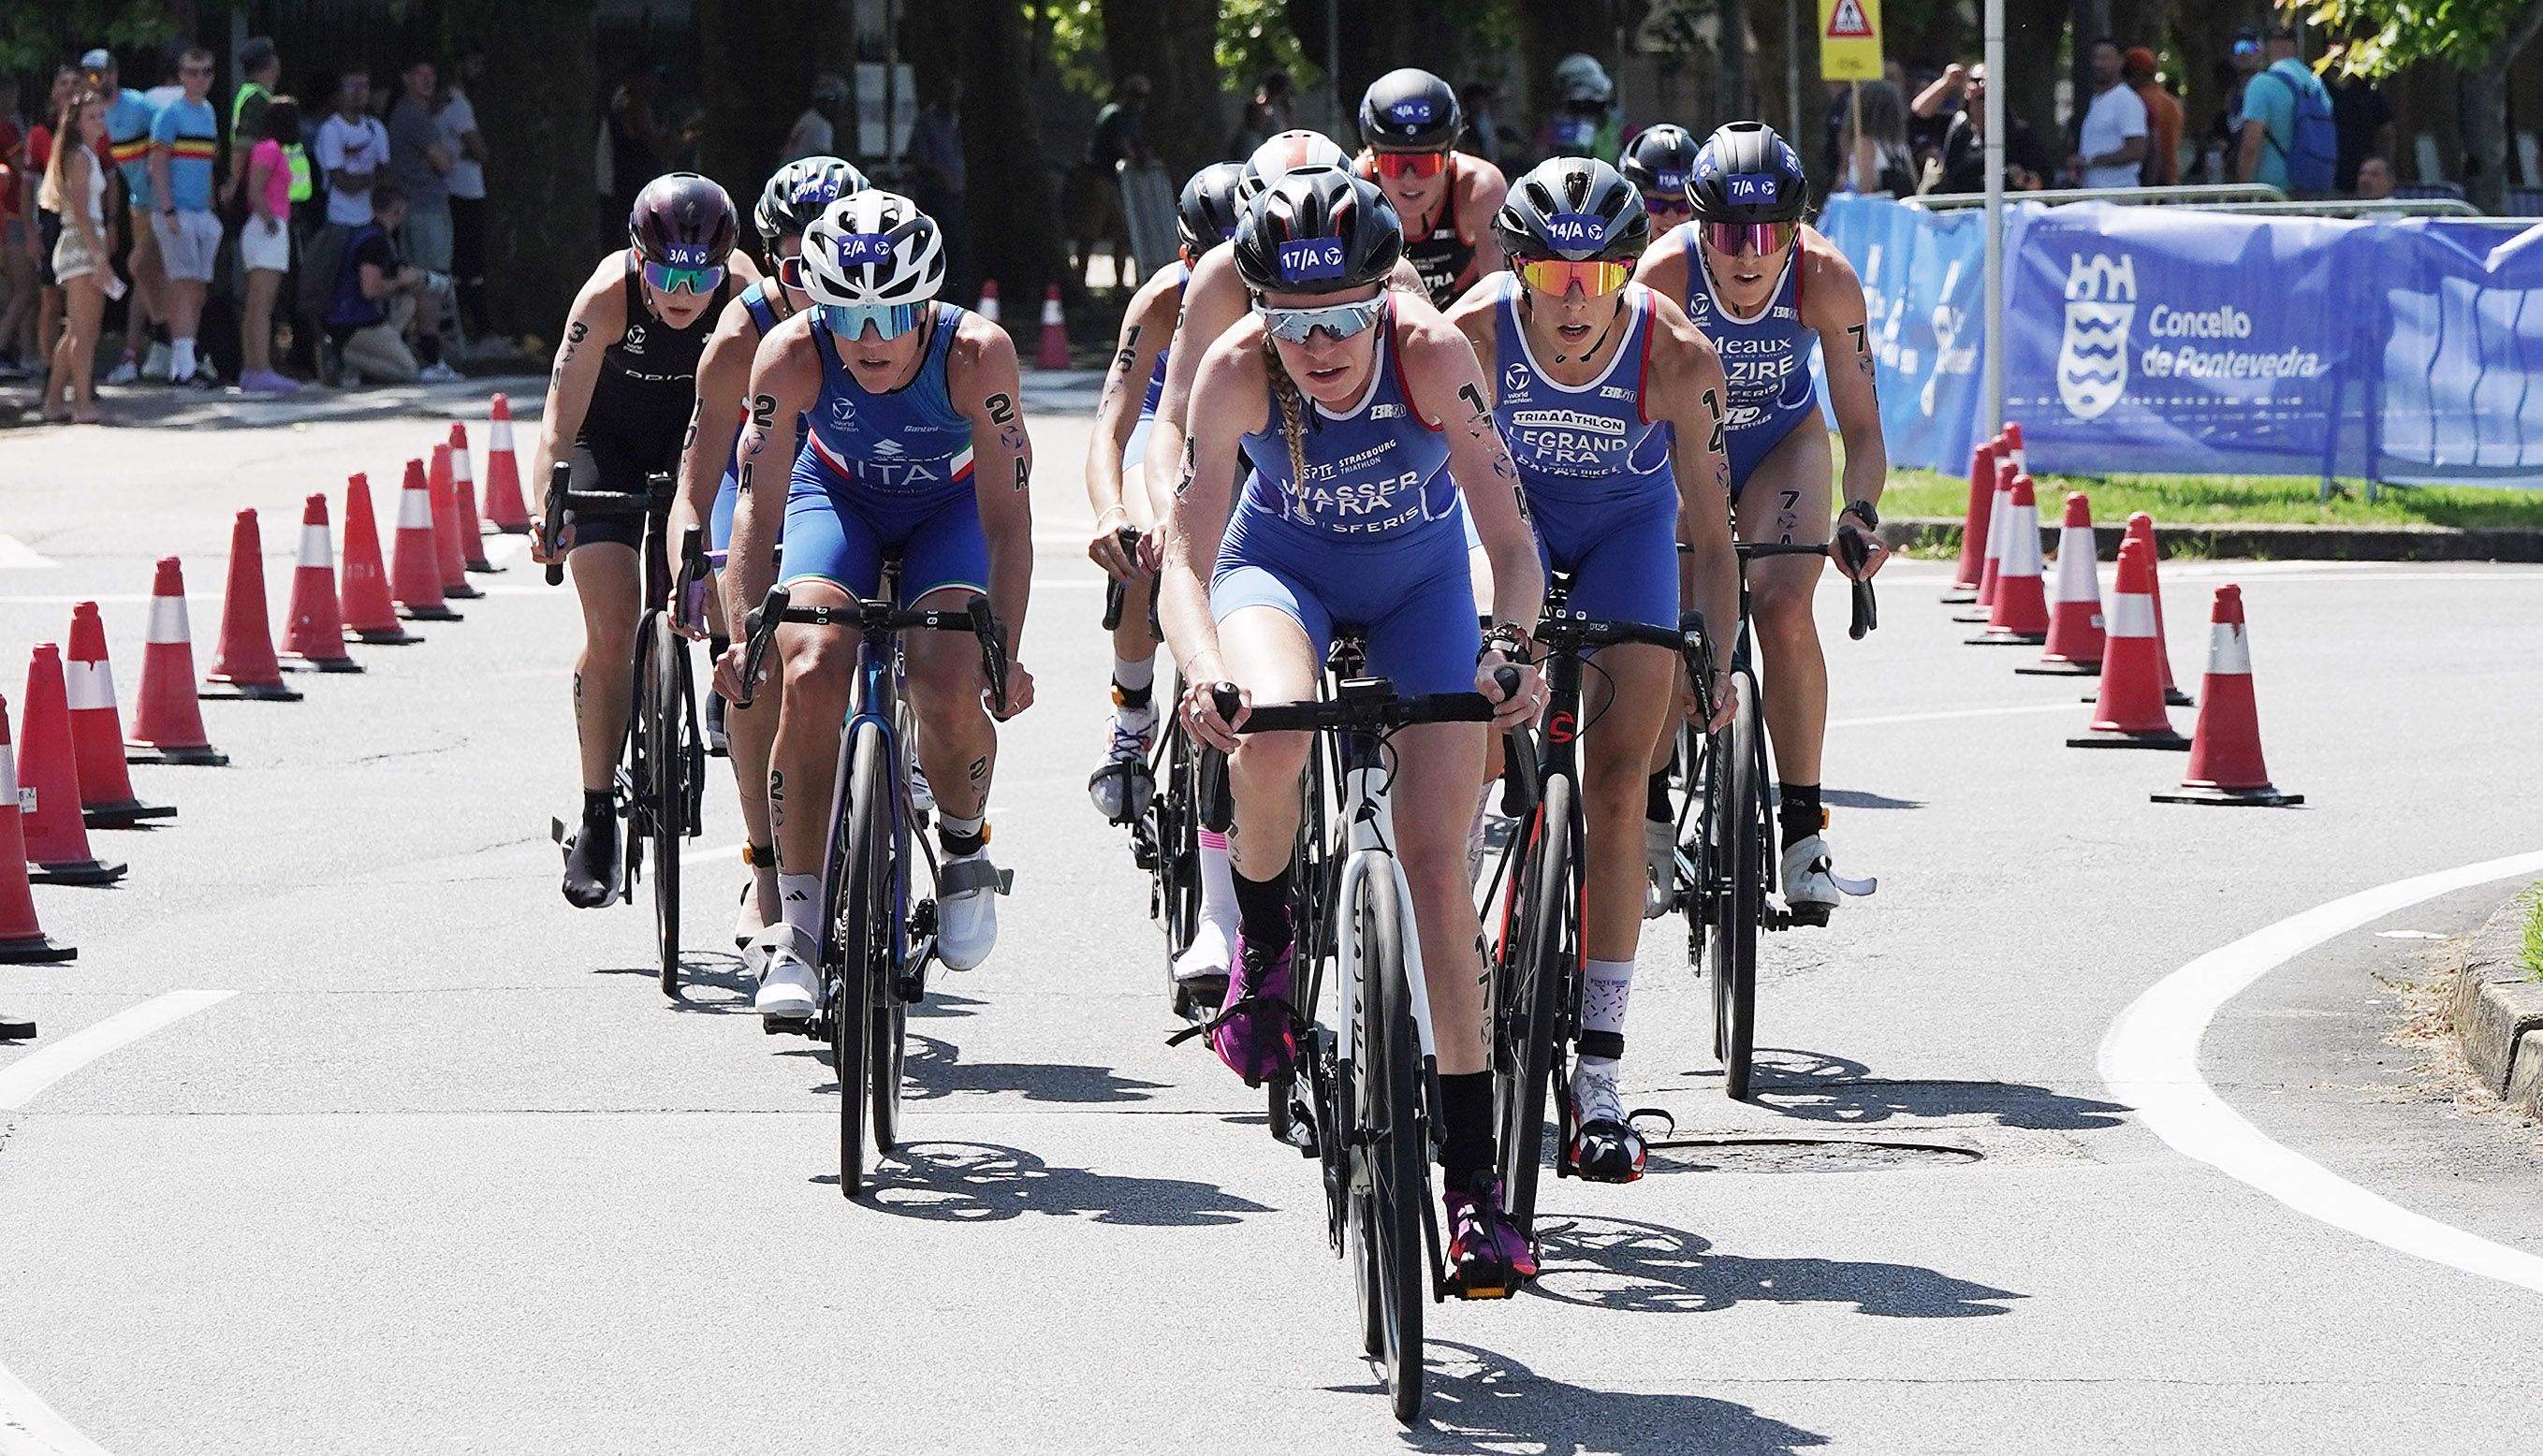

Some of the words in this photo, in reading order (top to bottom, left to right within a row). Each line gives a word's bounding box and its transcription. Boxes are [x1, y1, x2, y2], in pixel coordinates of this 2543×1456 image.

[1732, 180, 1755, 197] 7/A
[1547, 221, 1584, 241] 14/A
[669, 248, 689, 264] 3/A
[842, 240, 867, 258] 2/A
[1282, 248, 1320, 270] 17/A
[568, 320, 589, 344] 3
[2149, 303, 2251, 339] Concello
[1846, 324, 1864, 354] 7
[2141, 344, 2173, 377] de
[2174, 344, 2319, 378] Pontevedra
[1507, 391, 1528, 400] World
[753, 393, 777, 428] 2
[985, 392, 1015, 426] 2
[1516, 412, 1623, 431] TRIAAATHLON
[1508, 426, 1629, 452] LEGRAND
[1338, 439, 1397, 468] STRASBOURG
[1340, 456, 1381, 474] TRIATHLON
[1535, 446, 1600, 464] FRA
[857, 459, 940, 486] ITA
[1015, 455, 1029, 491] A
[1281, 470, 1420, 502] WASSER
[1314, 495, 1393, 517] FRA
[1779, 490, 1801, 511] 7
[1333, 505, 1419, 533] SFERIS
[769, 769, 784, 801] 2
